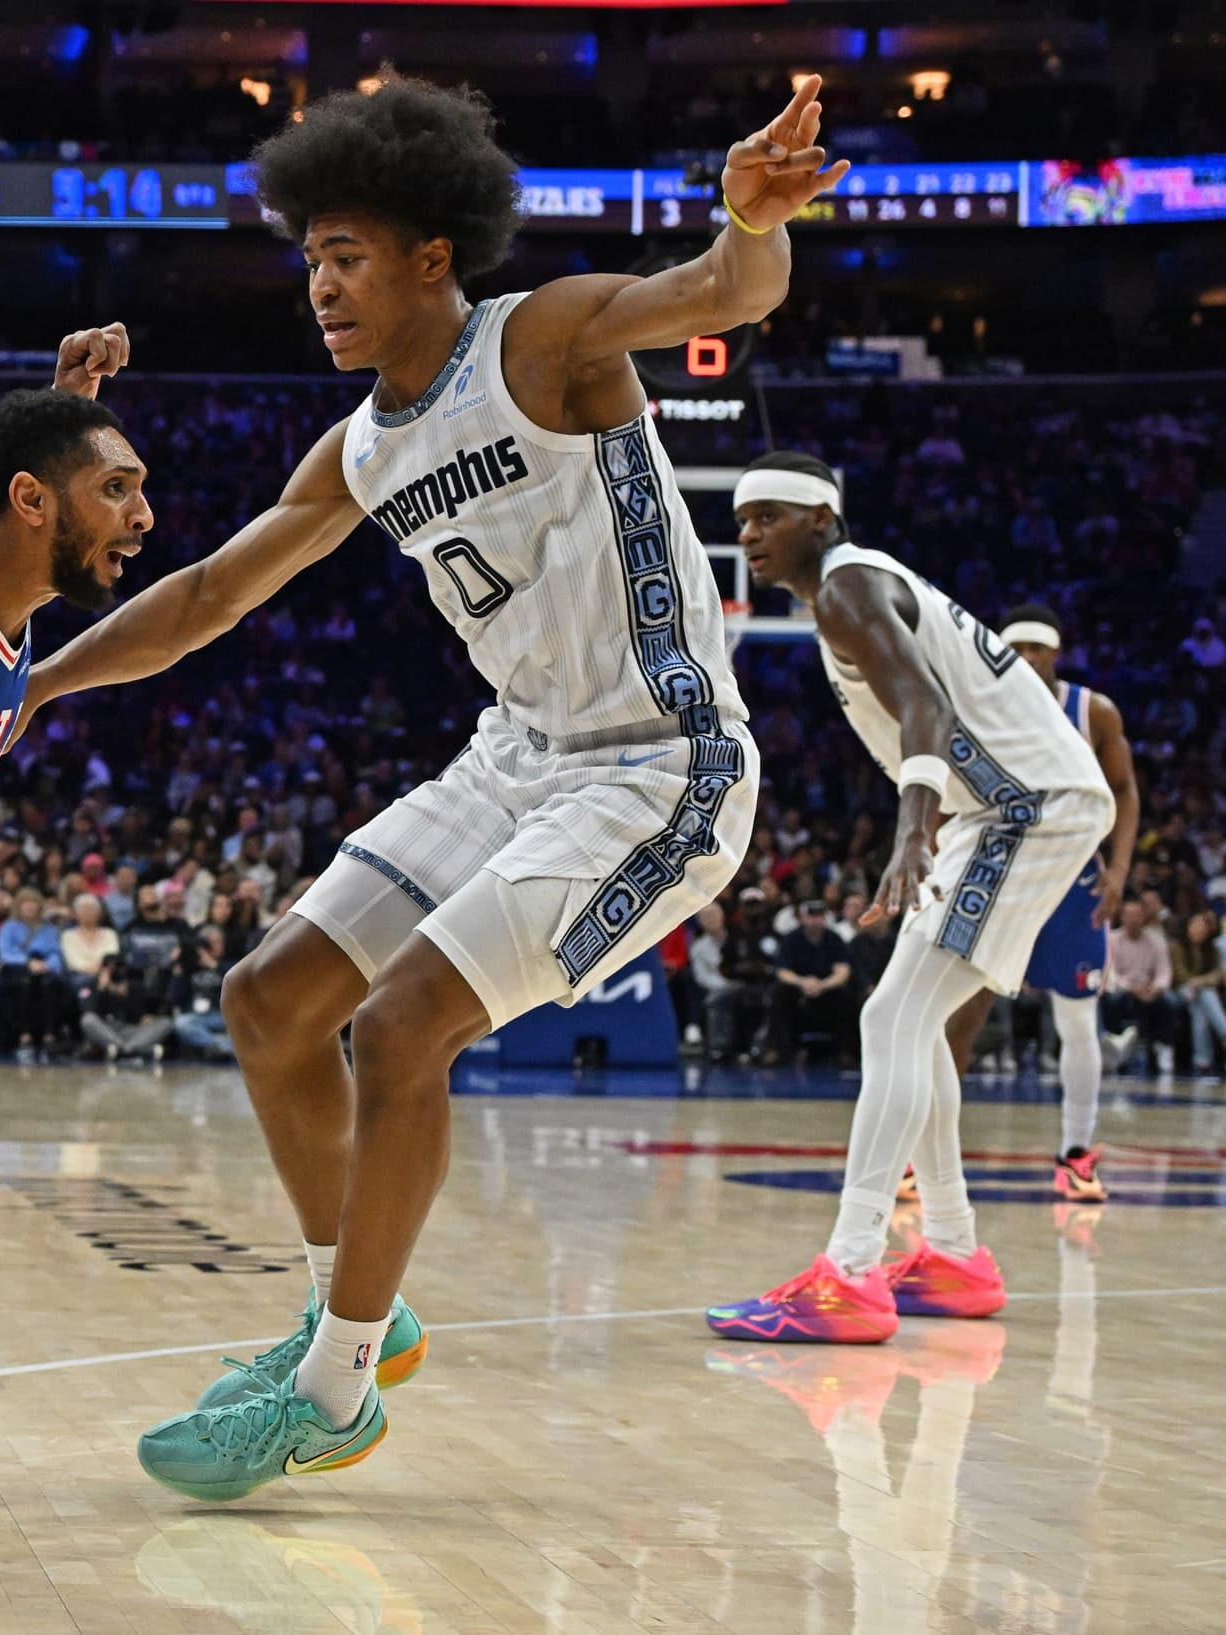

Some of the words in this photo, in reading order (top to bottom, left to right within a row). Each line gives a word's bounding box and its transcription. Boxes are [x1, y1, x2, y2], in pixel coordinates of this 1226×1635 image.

[660, 198, 682, 228] 3
[443, 391, 487, 421] Robinhood
[658, 399, 746, 420] TISSOT
[432, 536, 514, 619] 0
